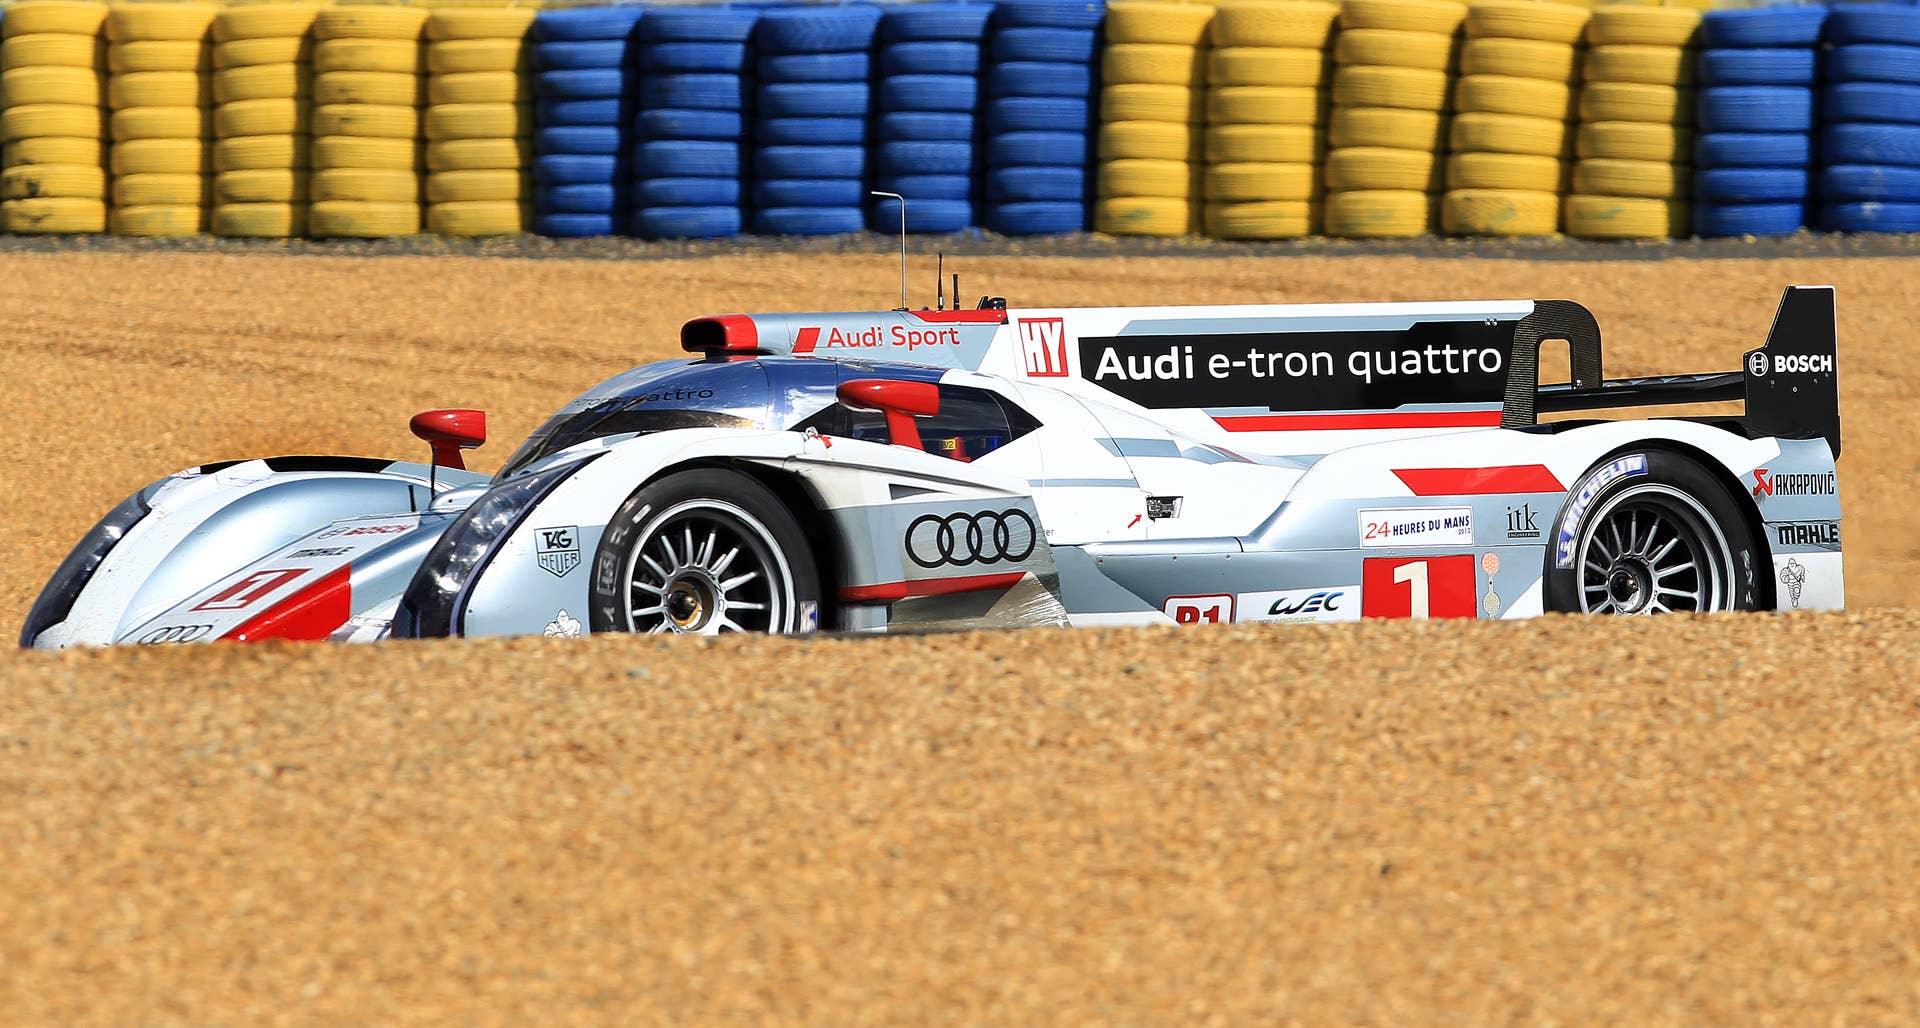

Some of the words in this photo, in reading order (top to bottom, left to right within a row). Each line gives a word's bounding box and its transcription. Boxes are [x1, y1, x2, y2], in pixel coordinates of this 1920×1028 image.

[827, 326, 883, 347] Audi
[892, 325, 960, 350] Sport
[1020, 320, 1066, 374] HY
[1095, 346, 1194, 380] Audi
[1208, 348, 1334, 378] e-tron
[1348, 344, 1502, 384] quattro
[1774, 355, 1832, 373] BOSCH
[1562, 455, 1644, 537] MICHELIN
[1365, 520, 1391, 540] 24
[1393, 522, 1426, 536] HEURES
[1428, 519, 1441, 531] DU
[1444, 515, 1470, 529] MANS
[1506, 503, 1539, 531] itk
[542, 529, 572, 549] TAG
[1778, 524, 1839, 545] MAHLE
[541, 553, 578, 573] HEUER
[1393, 560, 1429, 620] 1
[1267, 591, 1345, 616] WEC
